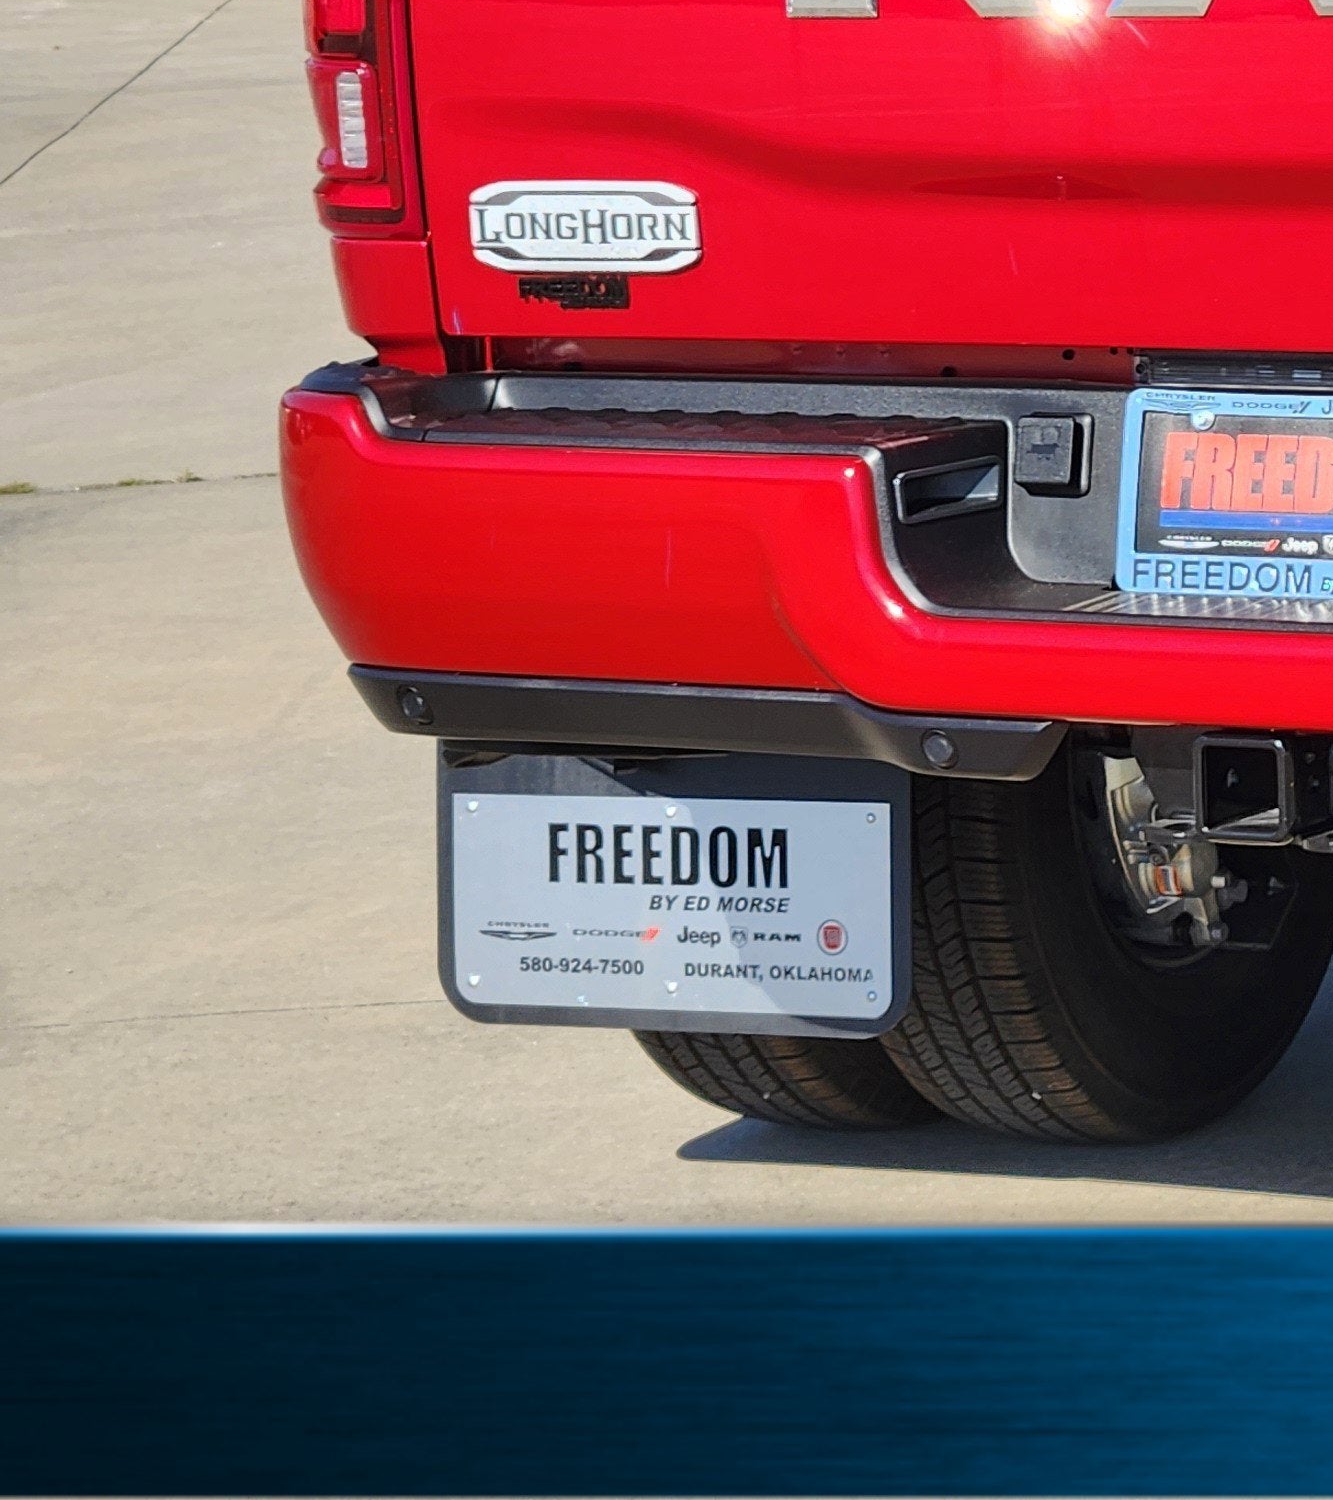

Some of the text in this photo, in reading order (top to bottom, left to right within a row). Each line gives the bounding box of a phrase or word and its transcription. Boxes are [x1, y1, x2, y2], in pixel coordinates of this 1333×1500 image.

[1281, 537, 1319, 555] Jeep
[1131, 558, 1313, 595] FREEDOM
[547, 821, 790, 890] FREEDOM
[648, 895, 790, 915] BY ED MORSE
[676, 925, 722, 948] Jeep
[753, 932, 802, 943] RAM
[519, 956, 874, 984] 580-924-7500 DURANT, OKLAHOMA
